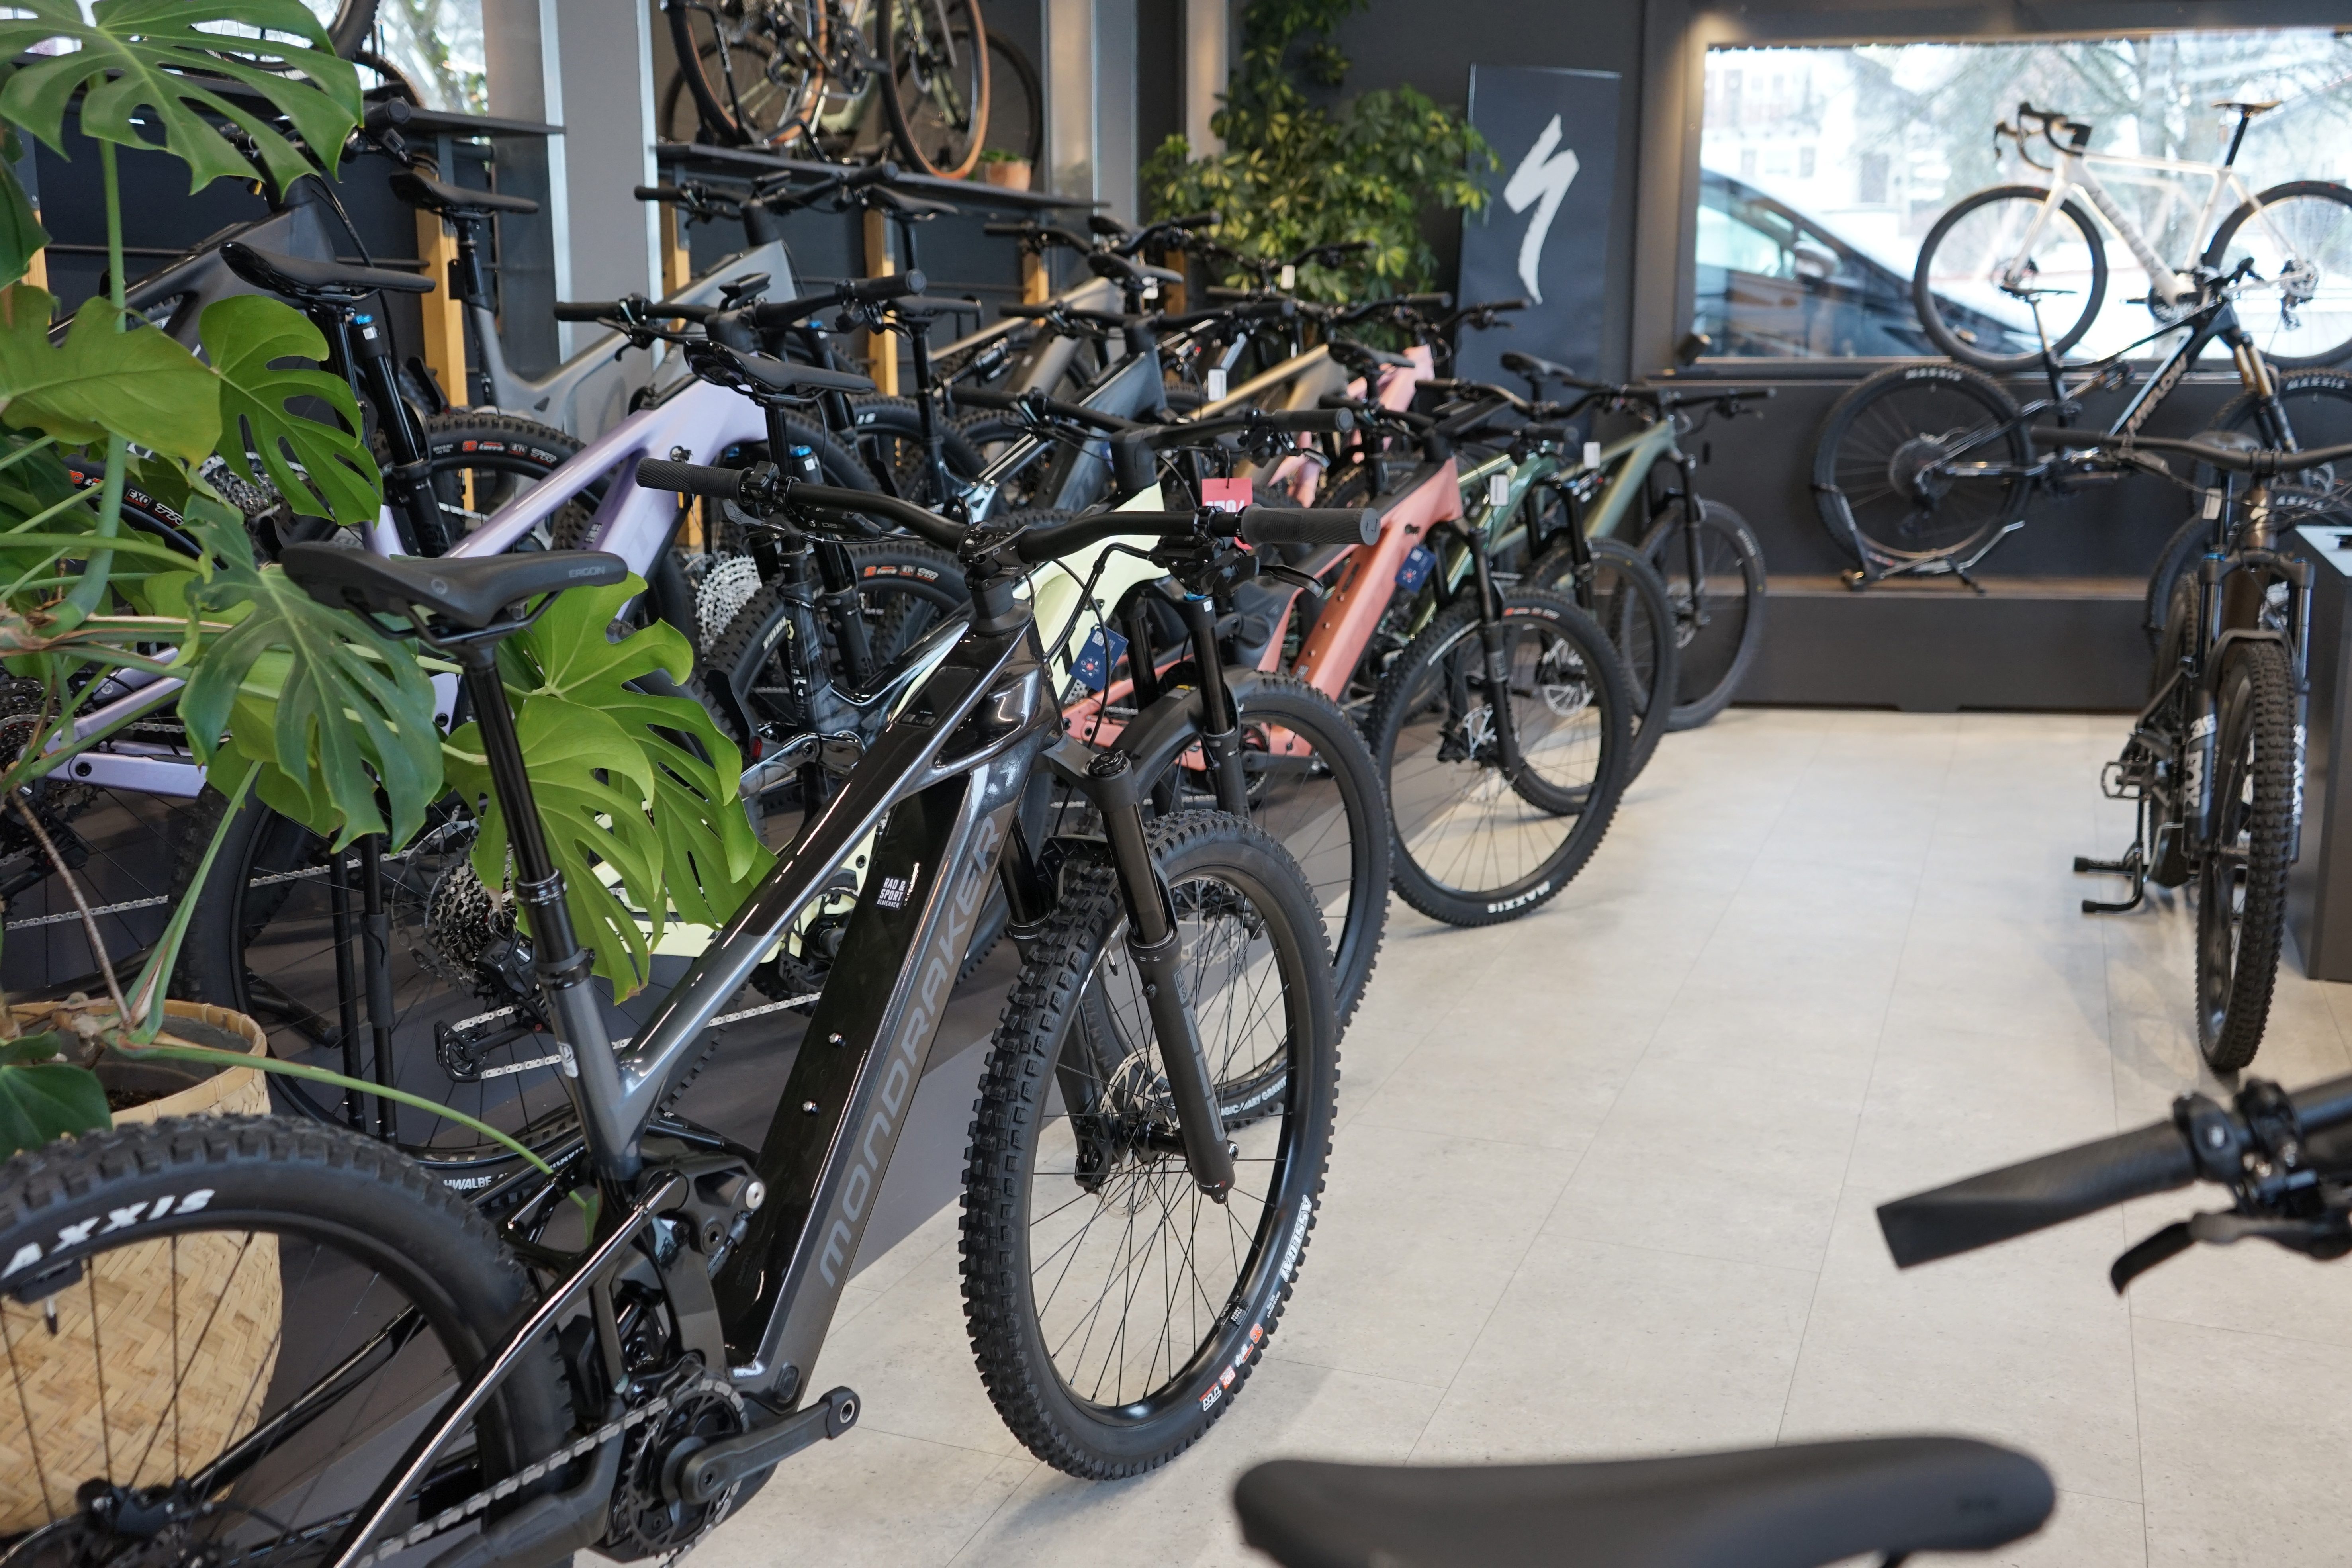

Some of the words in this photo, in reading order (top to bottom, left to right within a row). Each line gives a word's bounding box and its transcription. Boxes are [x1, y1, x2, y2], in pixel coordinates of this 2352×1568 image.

[2276, 496, 2324, 511] AXXIS
[569, 566, 605, 577] ERGON
[883, 878, 899, 890] RAD
[898, 881, 906, 891] &
[879, 889, 904, 902] SPORT
[1487, 881, 1551, 914] MAXXIS
[877, 899, 900, 908] BLAICHACH
[444, 1176, 492, 1190] HWALBE
[1, 1188, 215, 1279] AXXIS
[1280, 1194, 1312, 1283] ASSEGAI
[1202, 1386, 1222, 1411] TR
